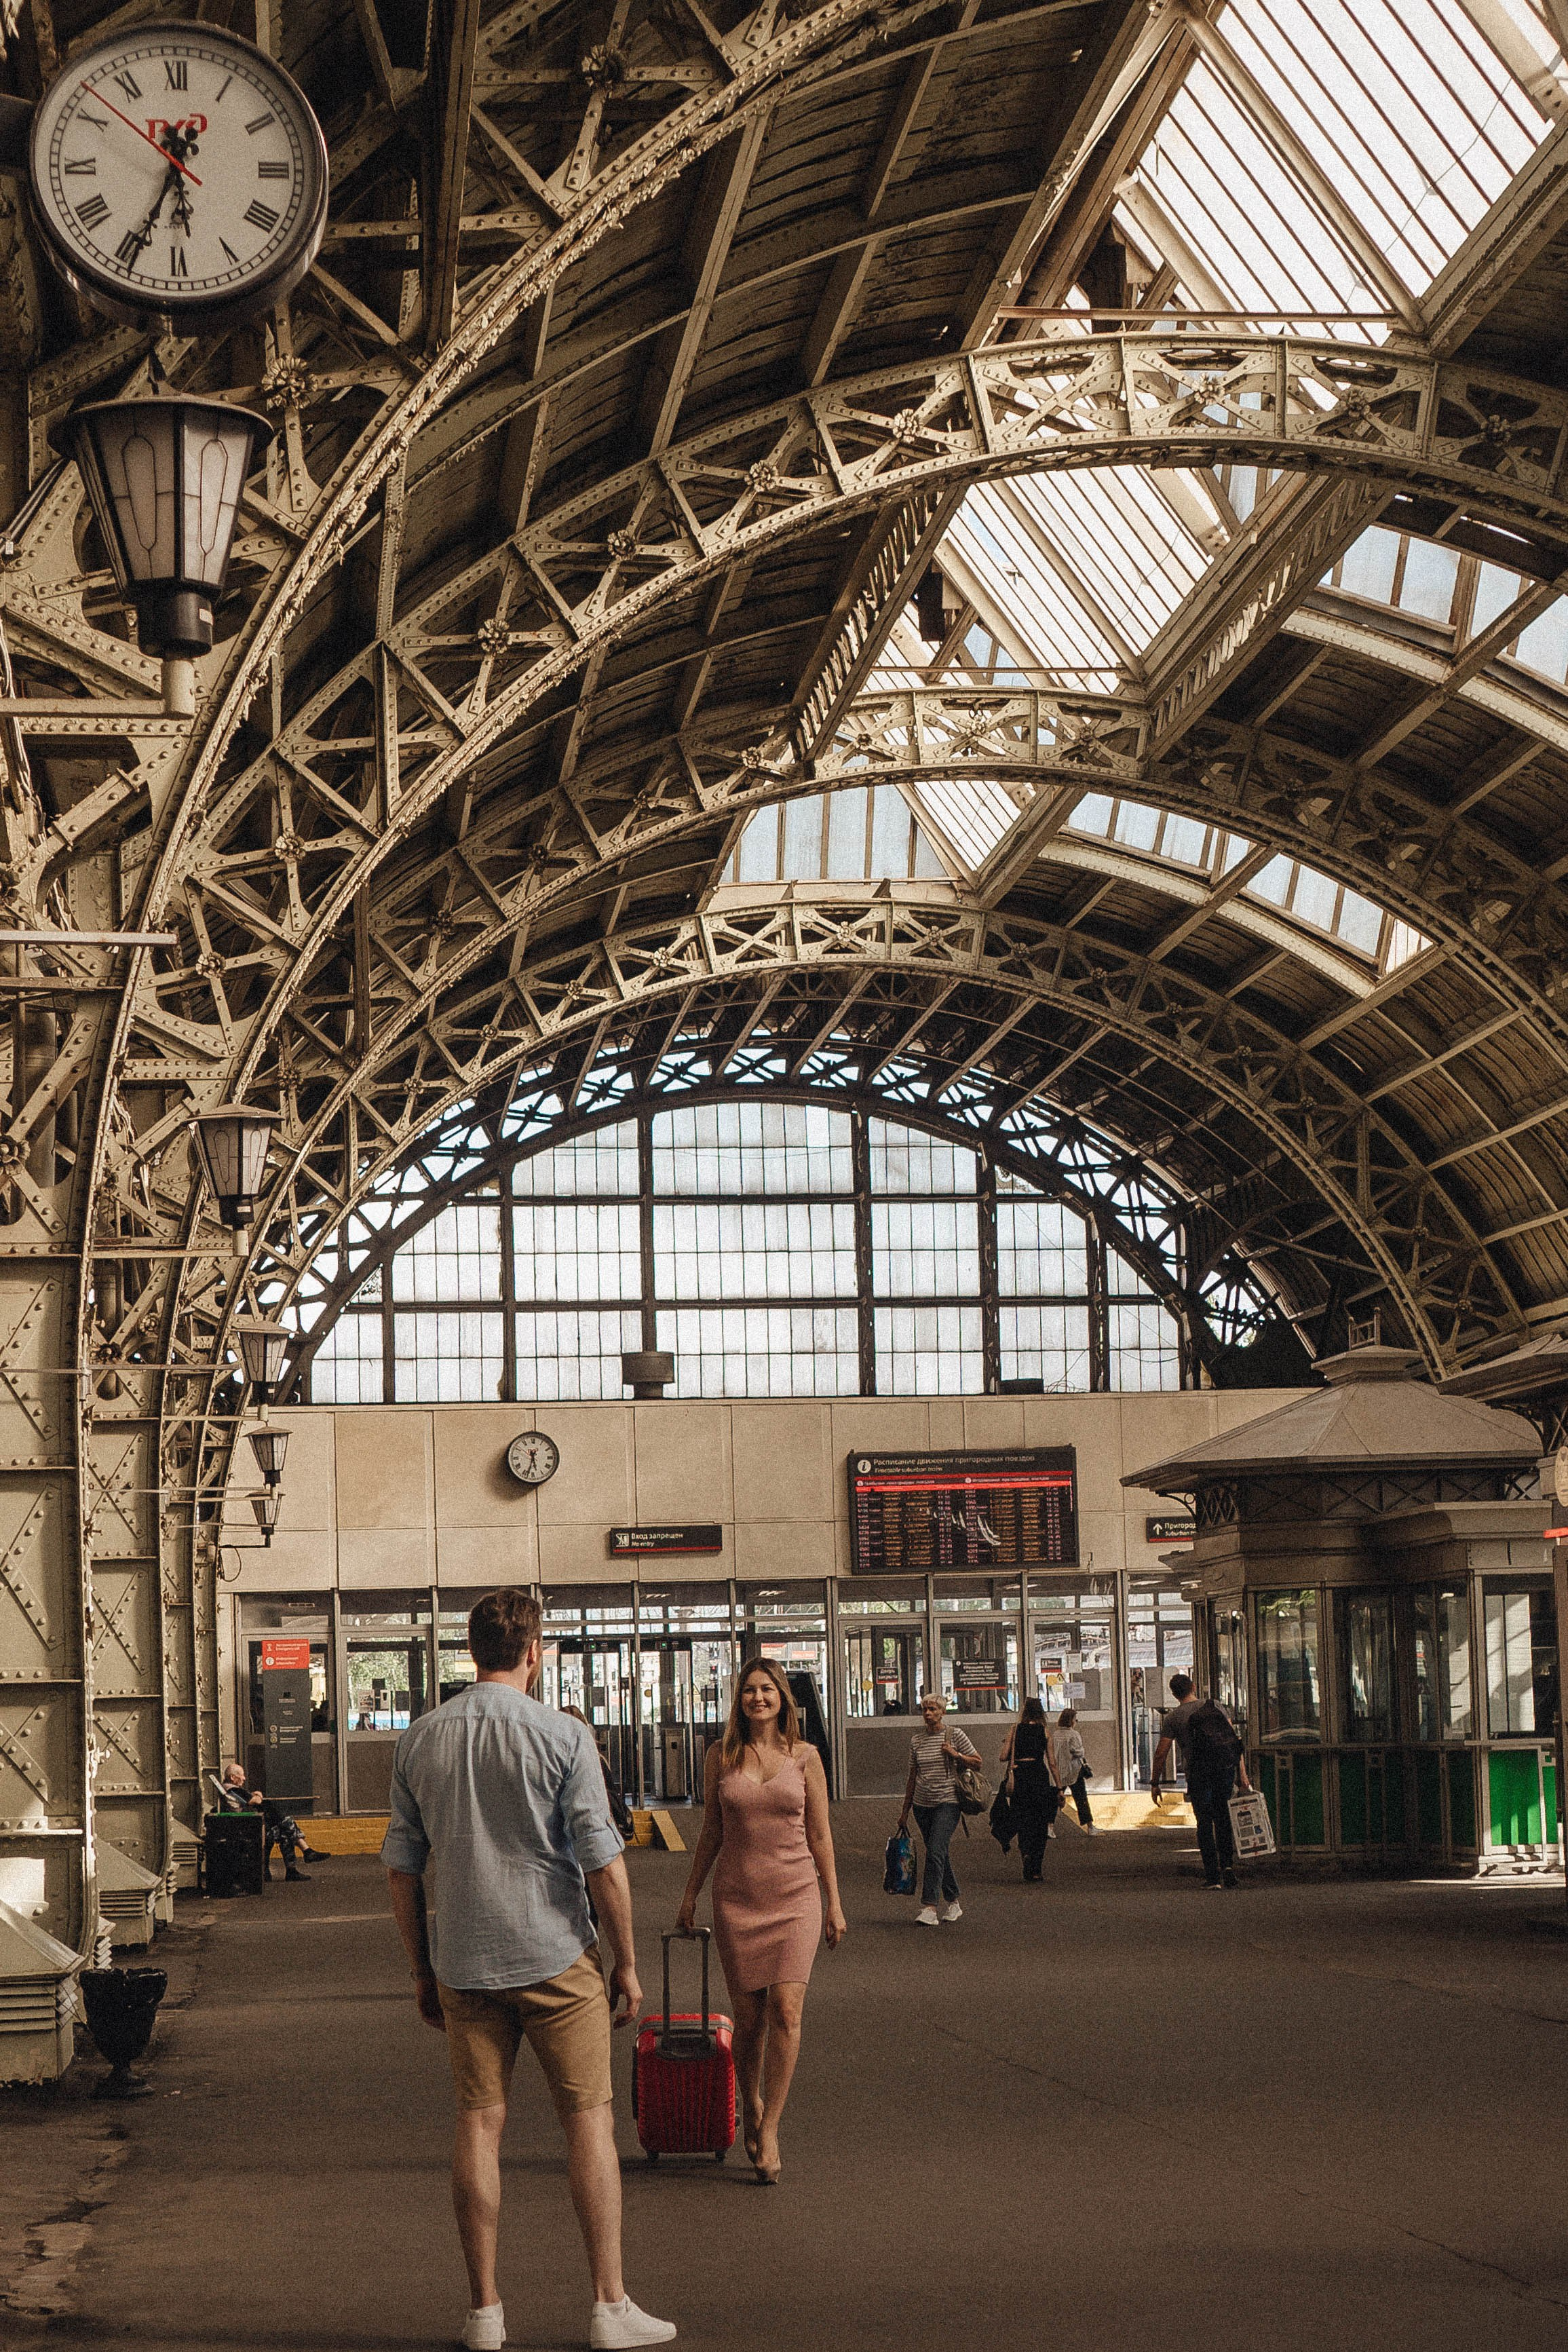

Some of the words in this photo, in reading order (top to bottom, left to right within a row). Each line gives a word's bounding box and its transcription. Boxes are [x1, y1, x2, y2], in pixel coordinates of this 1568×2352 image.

[113, 71, 142, 103] XI
[164, 60, 188, 91] XII
[78, 109, 109, 132] X
[245, 112, 275, 136] II
[64, 157, 96, 176] IX
[258, 162, 290, 179] III
[75, 193, 112, 232] VIII
[170, 246, 189, 277] VI
[631, 1532, 648, 1540] Вход
